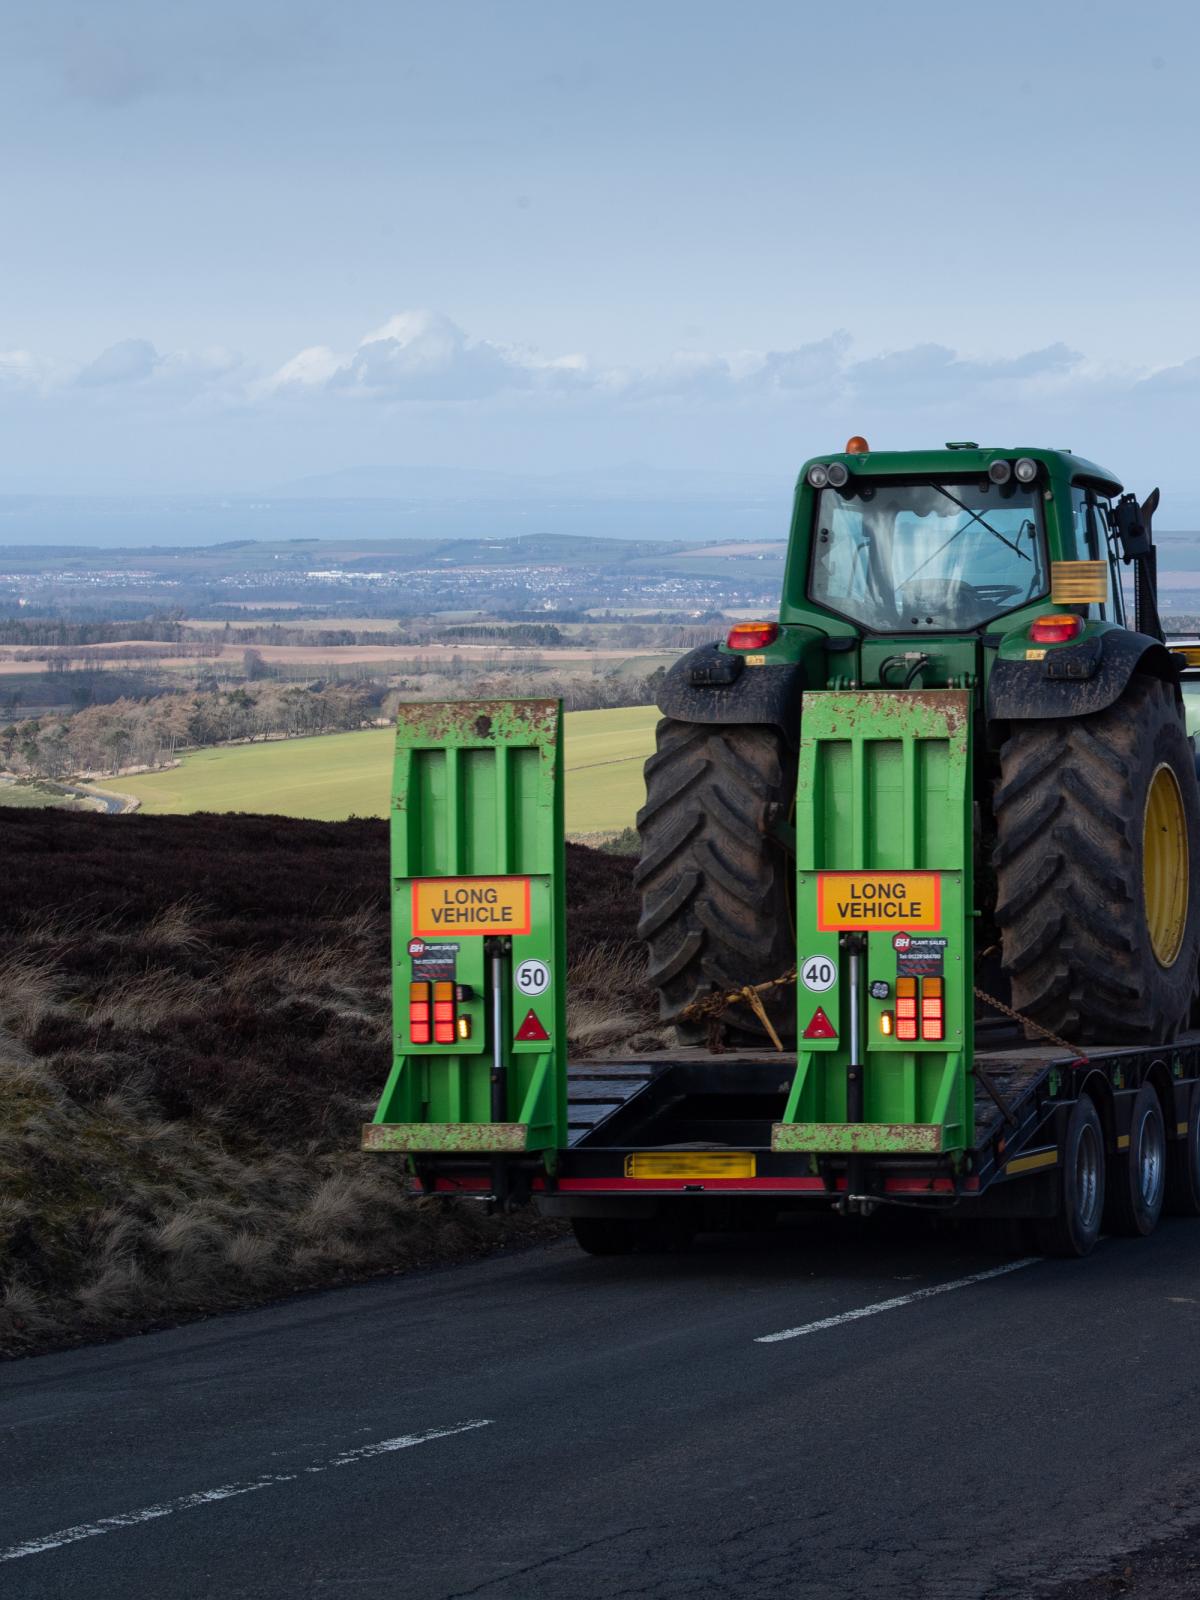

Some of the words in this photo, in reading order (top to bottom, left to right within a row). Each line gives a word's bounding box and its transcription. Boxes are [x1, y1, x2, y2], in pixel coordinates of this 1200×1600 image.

[444, 888, 498, 905] LONG
[850, 883, 906, 899] LONG
[431, 906, 513, 923] VEHICLE
[837, 902, 922, 918] VEHICLE
[409, 943, 425, 953] BH
[895, 938, 910, 947] BH
[520, 968, 545, 987] 50
[806, 964, 831, 983] 40
